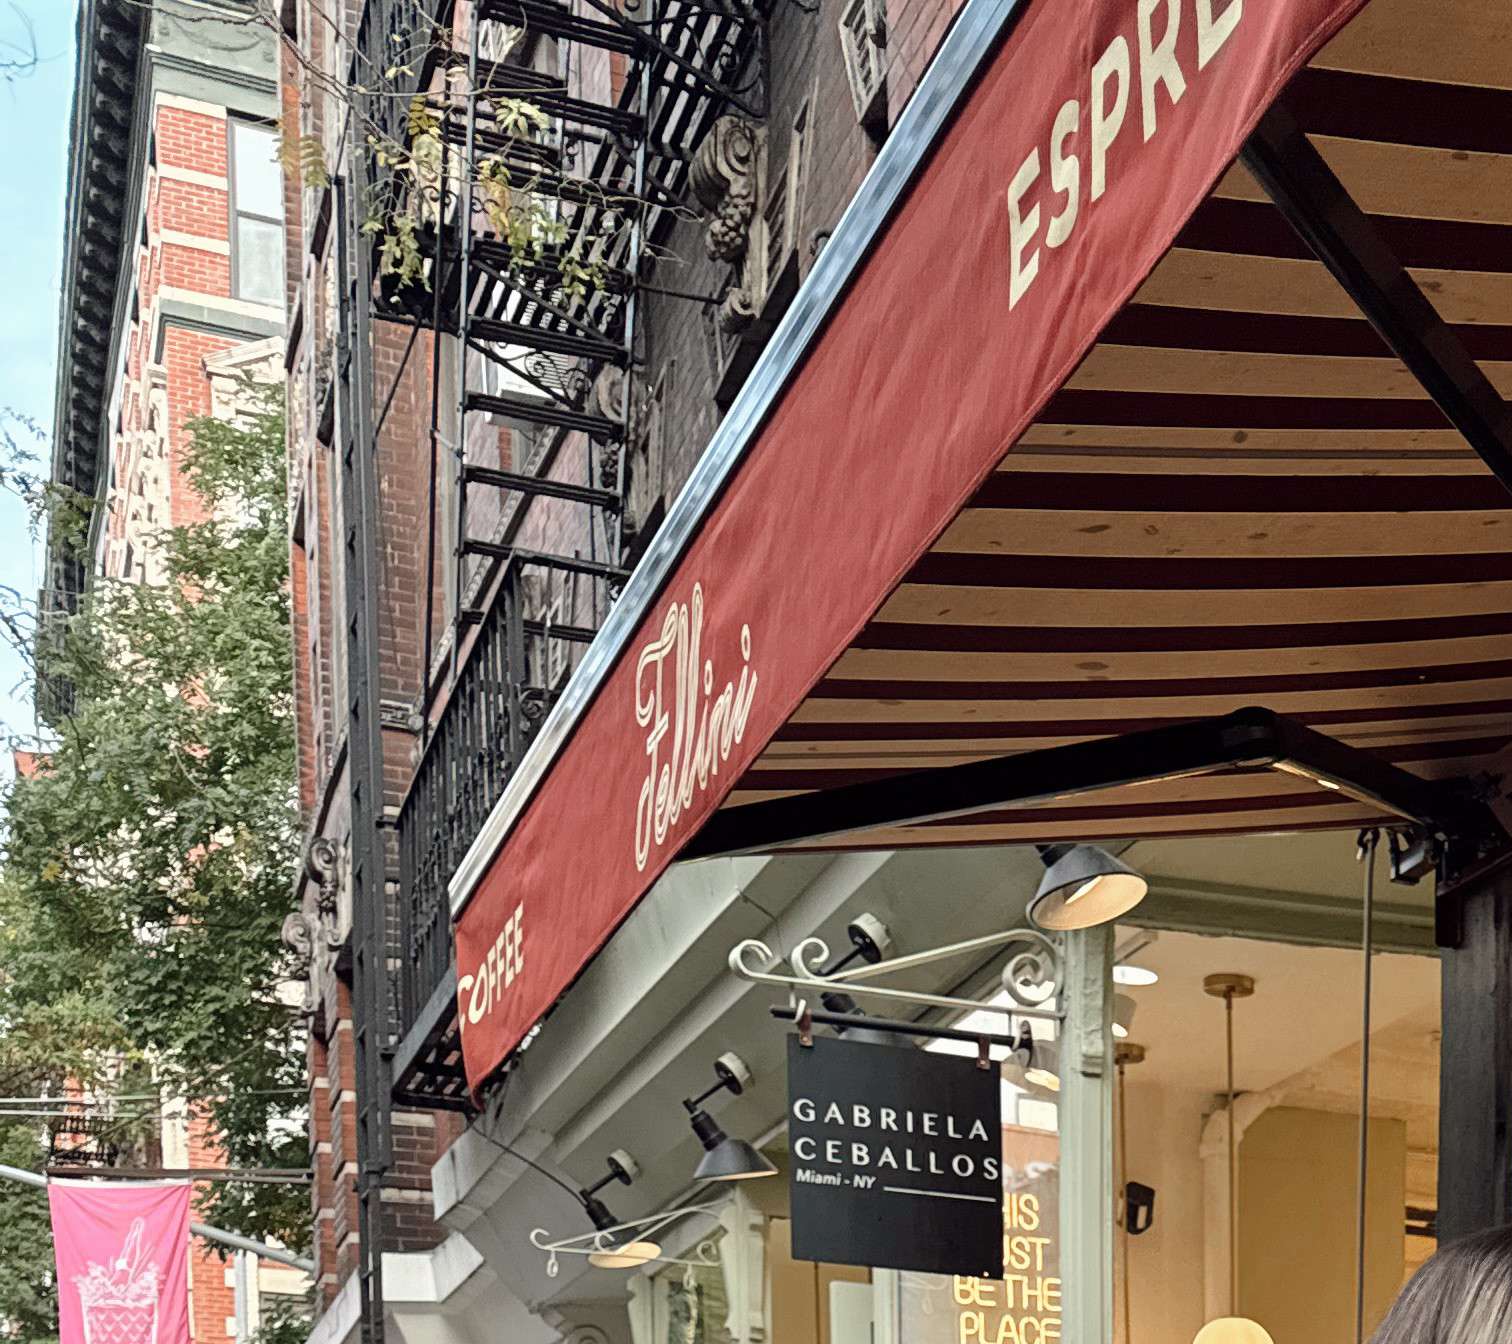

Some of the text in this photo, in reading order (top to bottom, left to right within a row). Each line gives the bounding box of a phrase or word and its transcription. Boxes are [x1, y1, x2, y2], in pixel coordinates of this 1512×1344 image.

[636, 581, 758, 871] Fellini
[457, 900, 524, 1036] COFFEE
[793, 1098, 988, 1141] GABRIELA
[794, 1137, 998, 1180] CEBALLOS
[796, 1168, 842, 1186] Miami
[853, 1174, 876, 1189] NY
[953, 1273, 1062, 1311] BE THE
